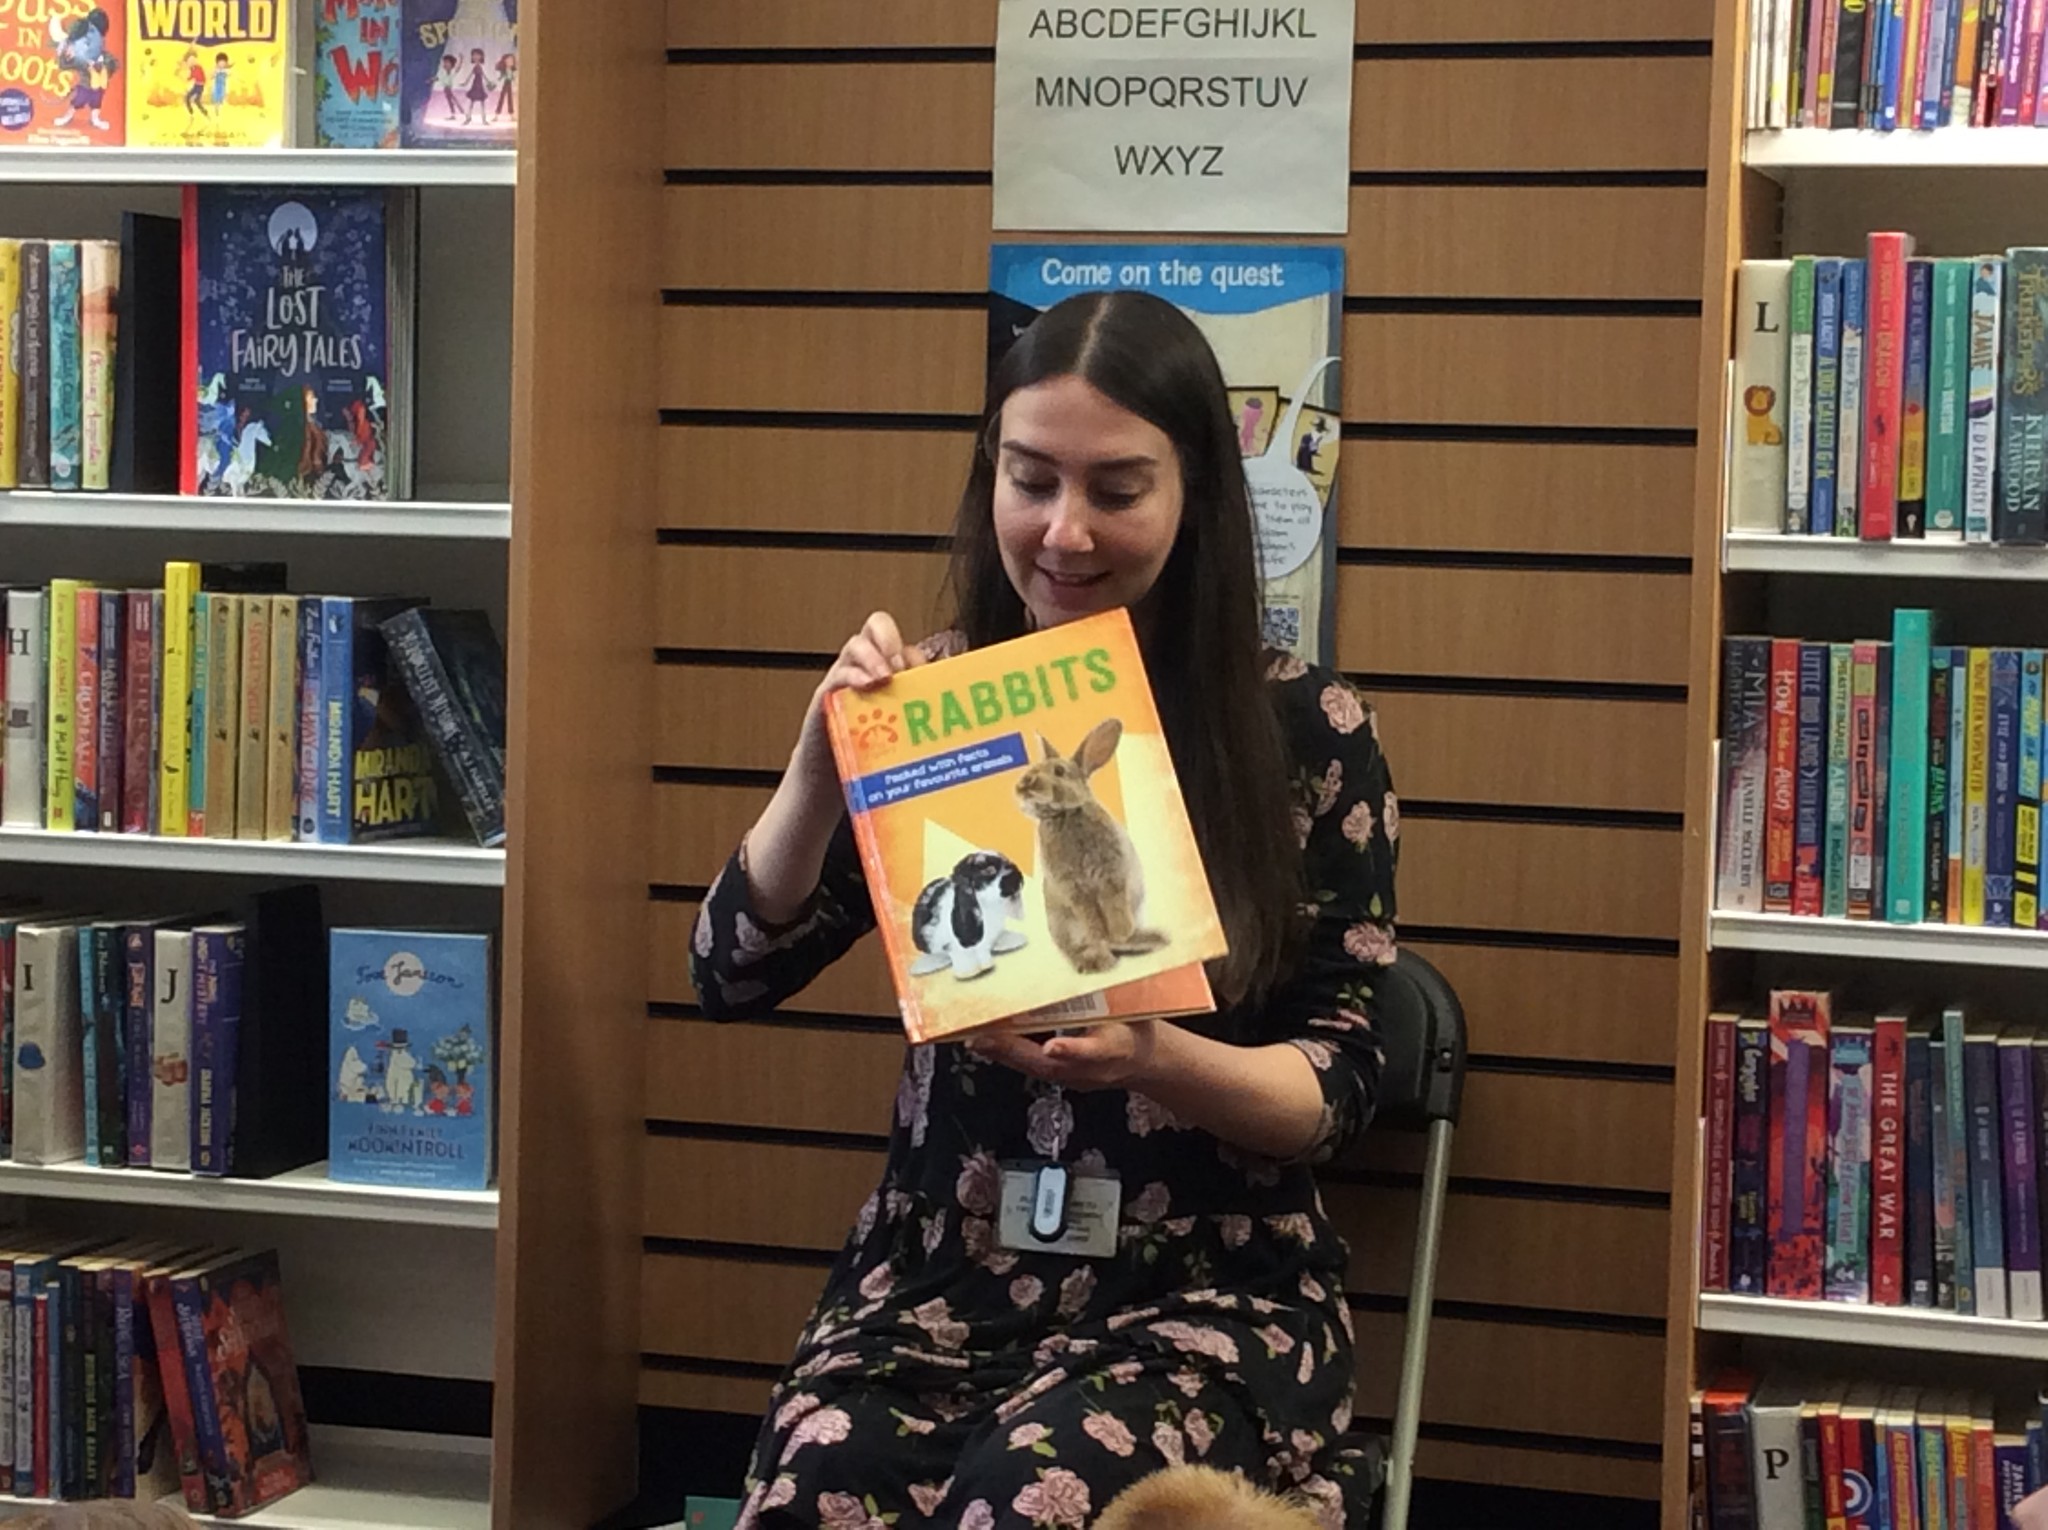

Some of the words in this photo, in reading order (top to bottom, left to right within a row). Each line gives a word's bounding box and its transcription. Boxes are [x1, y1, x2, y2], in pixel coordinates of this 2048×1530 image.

[18, 28, 43, 49] IN
[142, 0, 273, 38] WORLD
[1029, 8, 1317, 39] ABCDEFGHIJKL
[0, 51, 74, 97] oots
[1035, 77, 1308, 109] MNOPQRSTUV
[1114, 145, 1224, 177] WXYZ
[282, 265, 305, 288] THE
[1041, 257, 1112, 286] Come
[1119, 264, 1151, 286] on
[1159, 258, 1203, 286] the
[1210, 262, 1285, 293] quest
[267, 285, 327, 330] LOST
[1755, 301, 1779, 333] L
[1820, 318, 1834, 351] LACEY
[1972, 310, 1994, 370] JAMIE
[2013, 266, 2041, 397] TREEKEEPERS
[302, 330, 363, 374] TALES
[1876, 331, 1893, 388] DRAGON
[1968, 448, 1987, 515] LAPINSKI
[2007, 414, 2023, 512] LARWOOD
[2023, 414, 2043, 511] KIERAN
[7, 627, 31, 656] H
[1801, 650, 1820, 692] LITTLE
[903, 648, 1116, 746] RABBITS
[1742, 671, 1766, 728] MIA
[1773, 669, 1795, 714] HOW
[303, 711, 319, 748] WAY
[327, 700, 343, 769] MIRANDA
[355, 743, 434, 780] MIRANDA
[957, 748, 990, 764] facts
[326, 771, 343, 818] HART
[867, 790, 884, 803] on
[885, 783, 911, 800] your
[913, 767, 970, 789] favourite
[970, 754, 1014, 773] animals
[355, 777, 440, 826] HART
[1742, 776, 1755, 825] JANELLE
[21, 963, 33, 991] I
[161, 968, 178, 1004] J
[391, 960, 465, 989] Jansson
[1881, 1072, 1897, 1106] THE
[347, 1136, 466, 1161] MOOMINTROLL
[1880, 1116, 1897, 1183] GREAT
[1879, 1193, 1896, 1238] WAR
[1763, 1448, 1789, 1480] P
[2011, 1463, 2024, 1502] JAME
